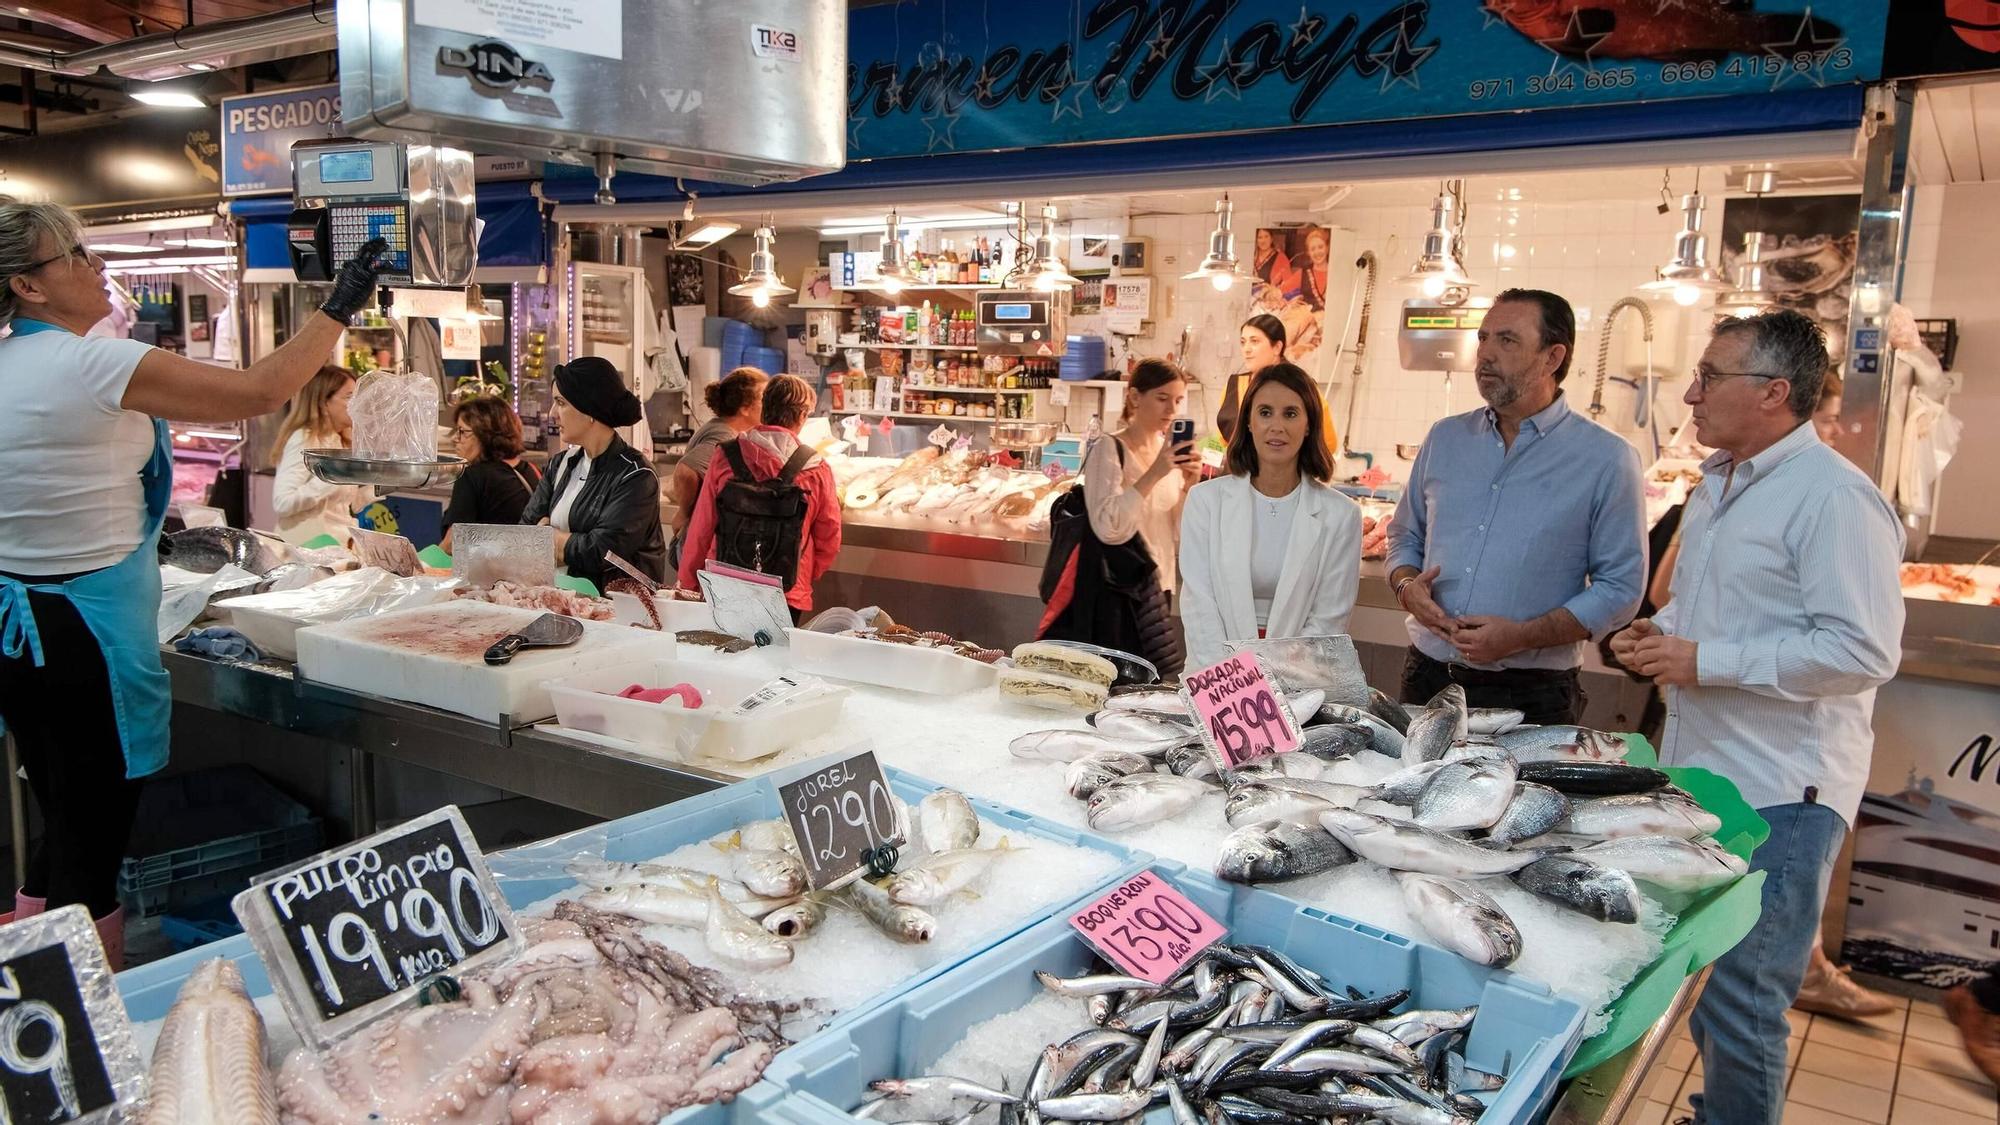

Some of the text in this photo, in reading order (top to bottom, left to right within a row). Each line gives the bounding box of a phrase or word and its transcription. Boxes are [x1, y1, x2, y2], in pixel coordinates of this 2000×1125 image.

[440, 46, 555, 81] DINA
[1085, 0, 1441, 121] Moya
[1470, 48, 1854, 99] 971 304 665 666 415 873
[491, 161, 516, 171] PUESTO
[1186, 658, 1245, 697] DORADA
[1208, 666, 1265, 706] NACIONAL
[1211, 690, 1291, 766] 15'99
[797, 761, 856, 813] JUREL
[800, 780, 902, 871] 12'90
[272, 848, 382, 919] PULPO
[1077, 876, 1152, 932] BOQUERON
[301, 867, 499, 1006] 19'90
[1102, 895, 1203, 976] 13'90
[0, 998, 82, 1125] 9
